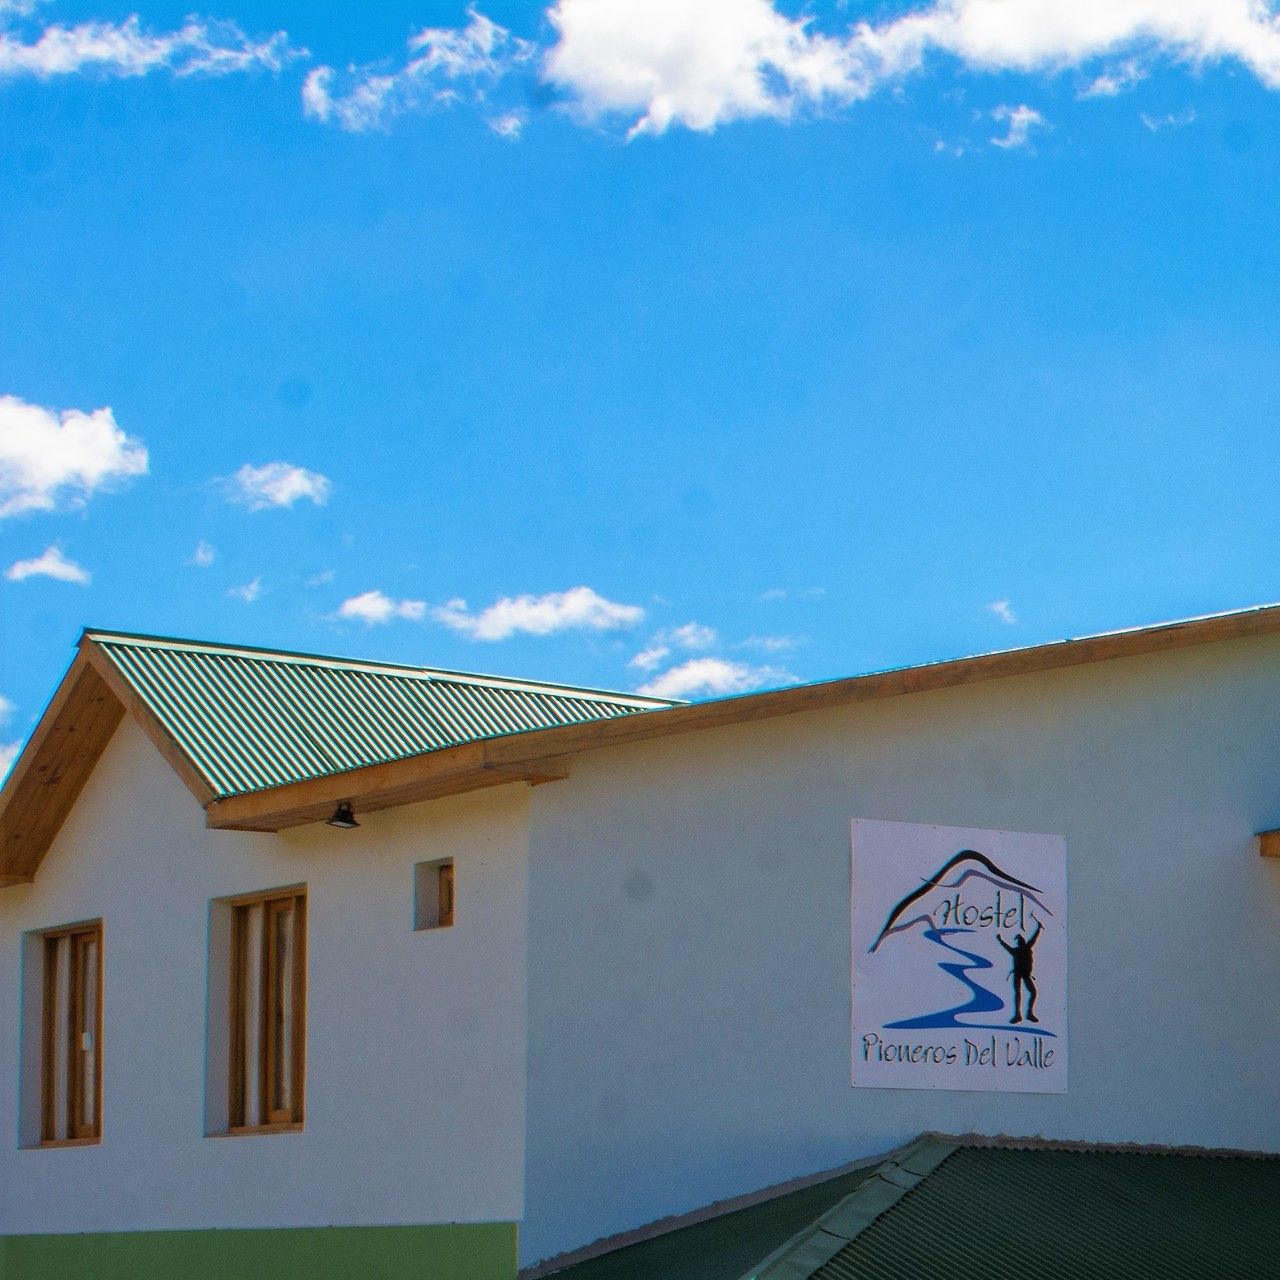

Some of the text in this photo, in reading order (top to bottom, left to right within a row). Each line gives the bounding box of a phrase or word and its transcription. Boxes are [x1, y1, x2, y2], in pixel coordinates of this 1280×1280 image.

[933, 890, 1028, 931] Hostel
[862, 1032, 1056, 1070] Pioneros Del Valle
